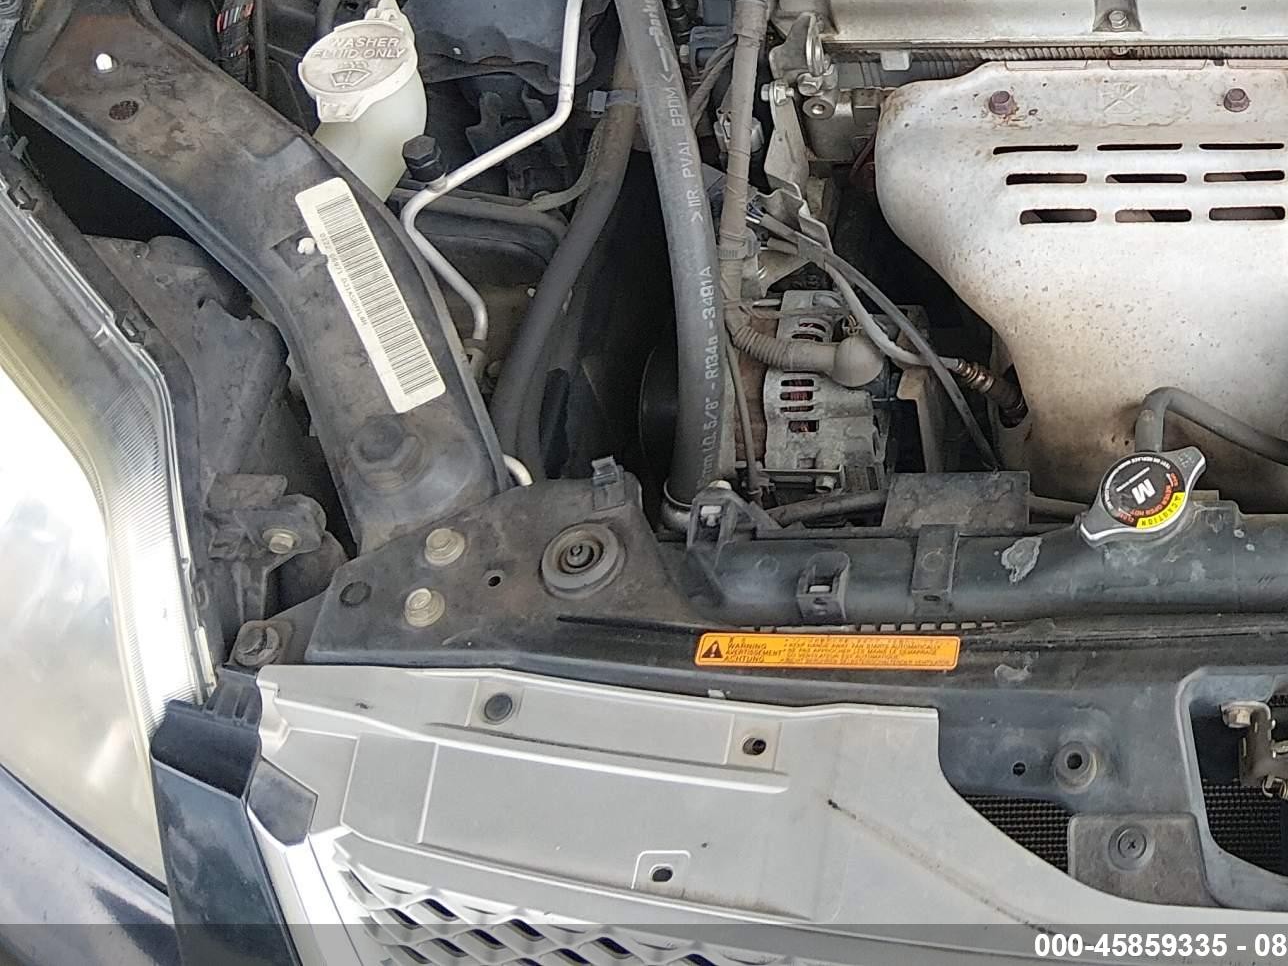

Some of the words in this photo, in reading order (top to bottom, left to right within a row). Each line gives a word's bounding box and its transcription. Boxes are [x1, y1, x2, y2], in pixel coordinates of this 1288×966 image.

[331, 36, 401, 49] WASHER
[309, 48, 360, 59] FLUID
[363, 47, 407, 59] ONLY
[1132, 478, 1156, 505] M
